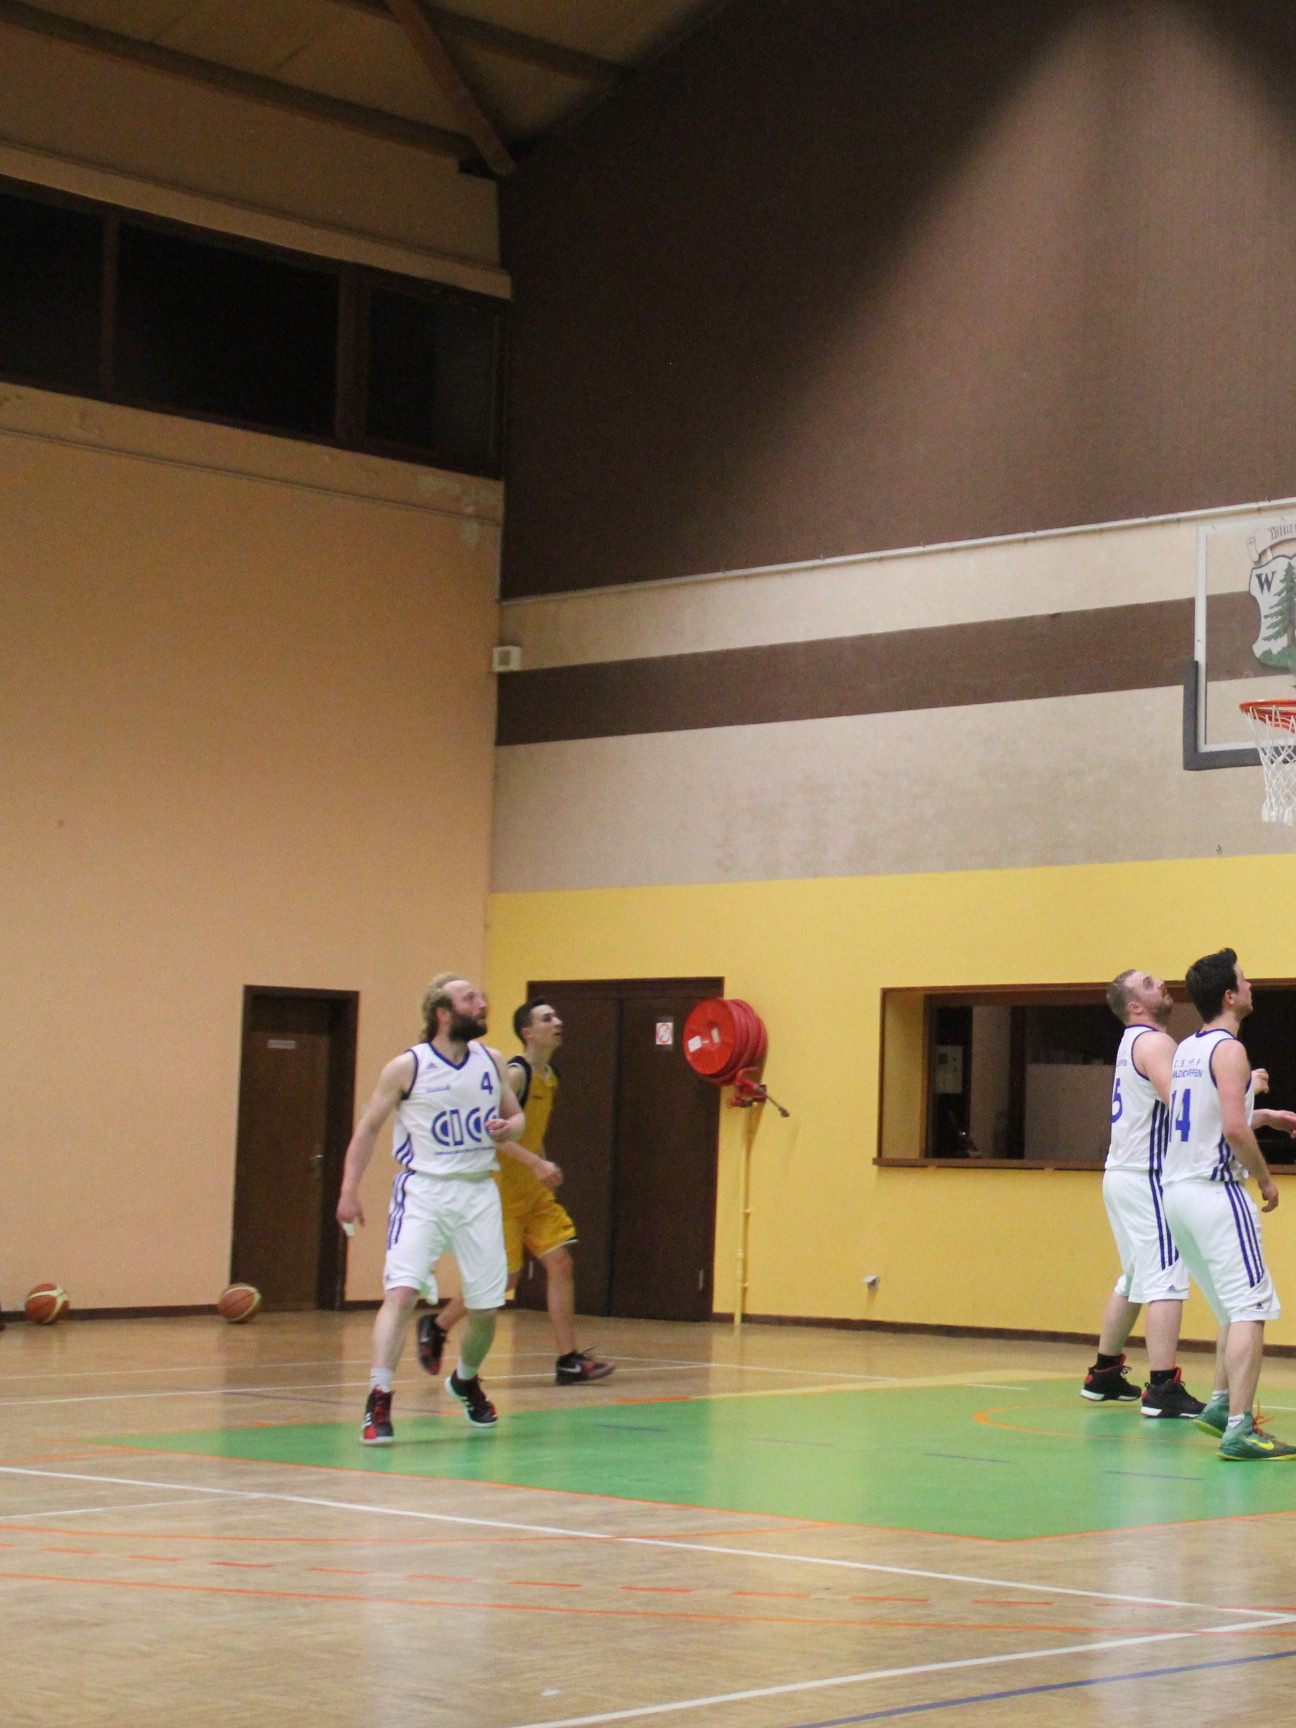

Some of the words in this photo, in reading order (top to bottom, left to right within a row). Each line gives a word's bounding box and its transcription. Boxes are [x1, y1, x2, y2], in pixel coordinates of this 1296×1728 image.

[1255, 570, 1277, 595] W
[480, 1071, 494, 1095] 4
[1169, 1088, 1191, 1142] 14
